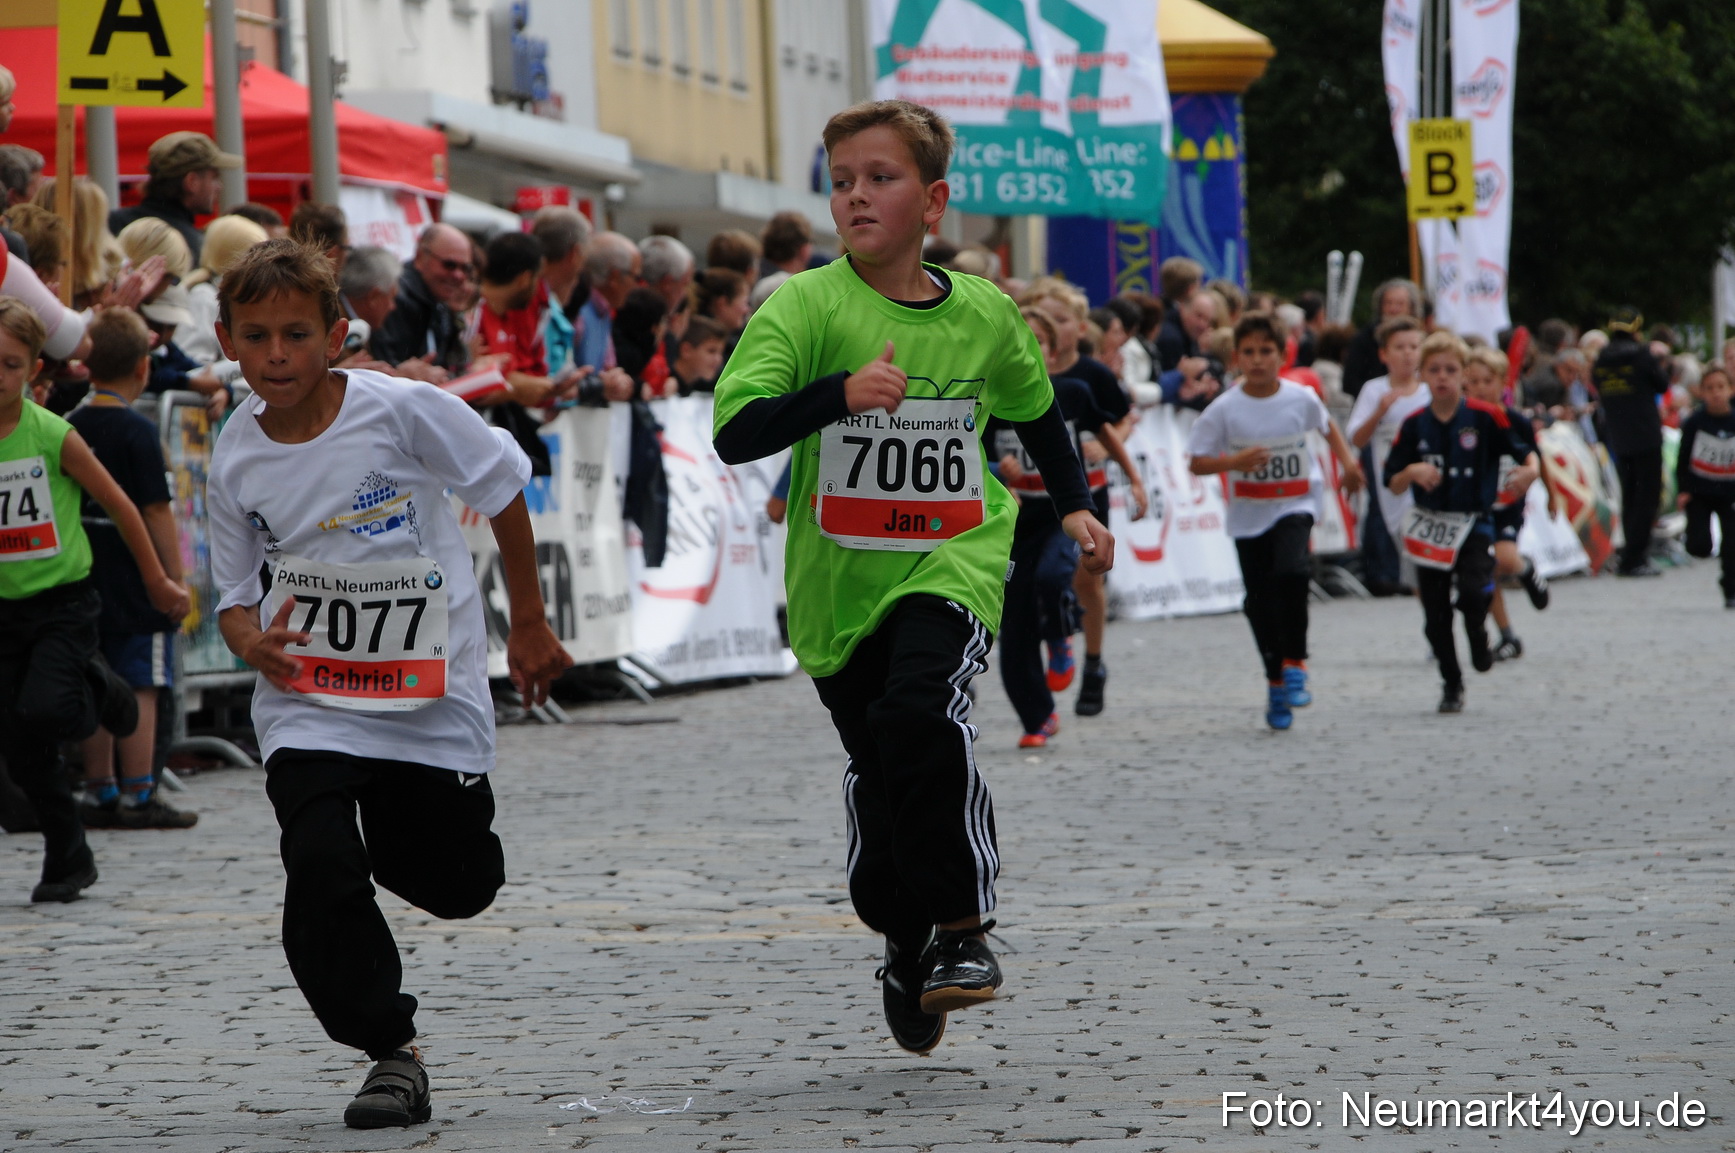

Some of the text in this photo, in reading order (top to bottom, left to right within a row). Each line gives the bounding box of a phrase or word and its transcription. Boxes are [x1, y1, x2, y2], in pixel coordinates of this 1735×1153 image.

[89, 0, 171, 57] A
[1427, 151, 1457, 196] B
[837, 414, 959, 431] ARTL Neumarkt
[842, 435, 966, 494] 7066
[826, 484, 834, 494] 6
[971, 486, 979, 497] M
[884, 508, 926, 532] Jan
[1407, 513, 1459, 546] 7305
[277, 569, 417, 593] PARTL Neumarkt
[293, 594, 427, 654] 7077
[433, 646, 443, 656] M
[313, 665, 403, 692] Gabriel
